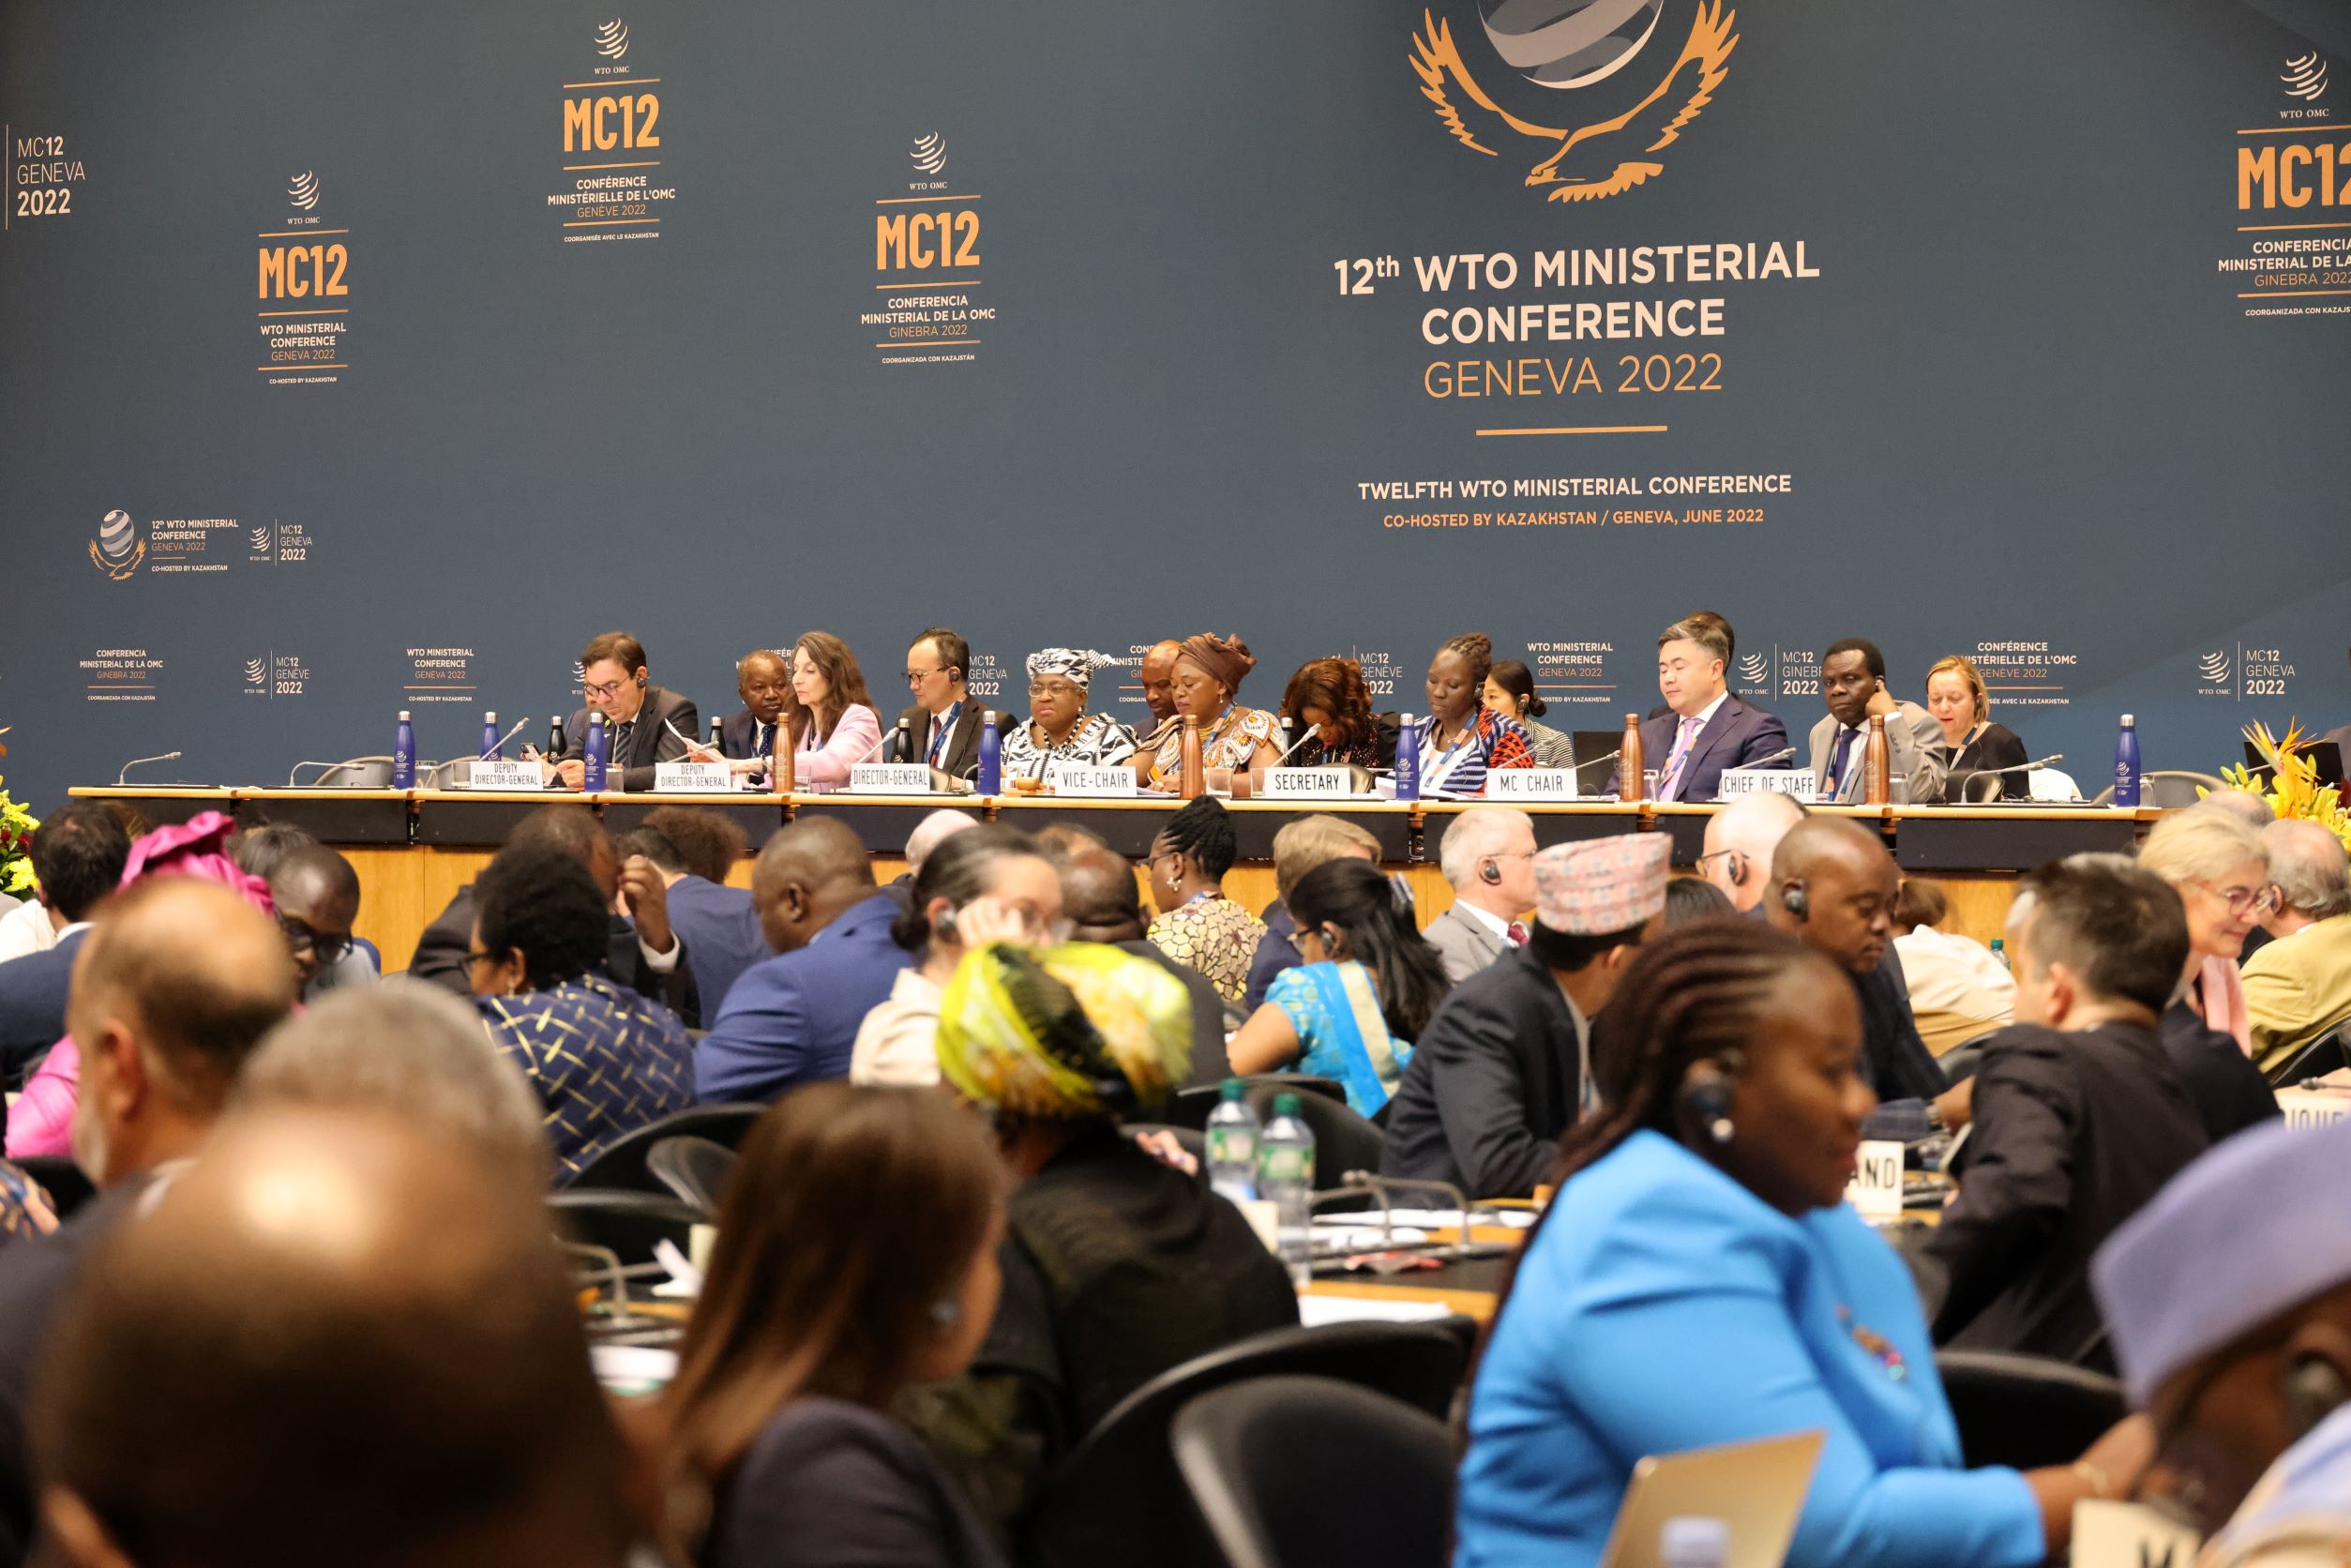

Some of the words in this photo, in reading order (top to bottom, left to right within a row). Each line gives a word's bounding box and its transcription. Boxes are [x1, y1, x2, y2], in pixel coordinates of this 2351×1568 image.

[2280, 110, 2302, 118] WTO
[2306, 109, 2328, 117] OMC
[564, 94, 659, 152] MC12
[18, 136, 63, 158] MC12
[17, 161, 85, 185] GENEVA
[577, 175, 646, 189] CONFÉRENCE
[18, 188, 70, 216] 2022
[548, 190, 624, 205] MINISTÉRIELLE
[626, 190, 640, 201] DE
[577, 204, 619, 218] GENÈVE
[622, 204, 646, 216] 2022
[877, 211, 980, 270] MC12
[1334, 255, 1399, 295] 12th
[1413, 252, 1517, 292] WTO
[1534, 241, 1819, 287] MINISTERIAL
[2219, 257, 2308, 271] MINISTERIAL
[2313, 256, 2331, 268] DE
[259, 244, 348, 298] MC12
[2254, 273, 2318, 287] GINEBRA
[888, 295, 968, 309] CONFERENCIA
[862, 311, 930, 324] MINISTERIAL
[934, 310, 948, 321] DE
[952, 309, 967, 321] LA
[970, 309, 995, 320] OMC
[2245, 308, 2303, 316] COORGANIZADA
[1422, 298, 1725, 345] CONFERENCE
[261, 324, 283, 335] WTO
[286, 323, 346, 334] MINISTERIAL
[889, 325, 939, 338] GINEBRA
[942, 324, 967, 336] 2022
[271, 336, 336, 348] CONFERENCE
[271, 350, 309, 361] GENEVA
[312, 349, 335, 359] 2022
[1424, 357, 1602, 398] GENEVA
[1619, 353, 1722, 392] 2022
[1358, 481, 1452, 500] TWELFTH
[1459, 480, 1507, 498] WTO
[1515, 477, 1642, 497] MINISTERIAL
[1649, 475, 1791, 494] CONFERENCE
[166, 520, 186, 529] WTO
[188, 519, 238, 528] MINISTERIAL
[1384, 514, 1469, 528] CO-HOSTED
[1473, 513, 1492, 526] BY
[1497, 511, 1596, 525] KAZAKHSTAN
[1612, 510, 1678, 527] GENEVA,
[1682, 509, 1722, 522] JUNE
[1726, 509, 1763, 522] 2022
[152, 531, 205, 540] CONFERENCE
[280, 525, 302, 535] MC12
[151, 542, 184, 551] GENEVA
[186, 542, 205, 550] 2022
[280, 536, 312, 547] GENEVA
[280, 549, 306, 561] 2022
[1528, 642, 1550, 652] WTO
[1553, 642, 1613, 651] MINISTERIAL
[1978, 641, 2048, 652] CONFÉRENCE
[277, 656, 298, 667] MC12
[969, 656, 995, 667] MC12
[1361, 653, 1389, 664] MC12
[1538, 656, 1603, 664] CONFERENCE
[1783, 652, 1814, 663] MC12
[2027, 656, 2042, 664] DE
[2247, 650, 2280, 661] MC12
[414, 659, 465, 668] CONFERENCE
[97, 671, 128, 679] GINEBRA
[129, 671, 145, 679] 2022
[276, 667, 309, 679] GENÈVE
[414, 671, 445, 679] GENEVA
[447, 671, 465, 679] 2022
[969, 669, 1007, 679] GENEVA
[1361, 665, 1403, 678] GENÈVE
[1538, 668, 1576, 677] GENEVA
[1579, 668, 1602, 677] 2022
[1980, 667, 2020, 678] GENÈVE
[2023, 669, 2047, 678] 2022
[2246, 665, 2296, 677] GENEVA
[277, 682, 302, 694] 2022
[969, 682, 1000, 695] 2022
[1364, 681, 1394, 695] 022
[1783, 680, 1818, 694] 2022
[2247, 680, 2284, 695] 2022
[494, 763, 518, 774] DEPUTY
[681, 764, 704, 775] DEPUTY
[475, 775, 538, 785] DIRECTOR-GENERAL
[661, 776, 726, 787] DIRECTOR-GENERAL
[853, 769, 927, 786] DIRECTOR-GENERAL
[1062, 772, 1128, 788] VICE-CHAIR
[1275, 774, 1339, 791] SECRETARY
[1500, 776, 1517, 792] MC
[1527, 775, 1563, 792] CHAIR
[1725, 776, 1754, 793] CHIEF
[1762, 776, 1774, 791] OF
[1783, 777, 1814, 793] STAFF
